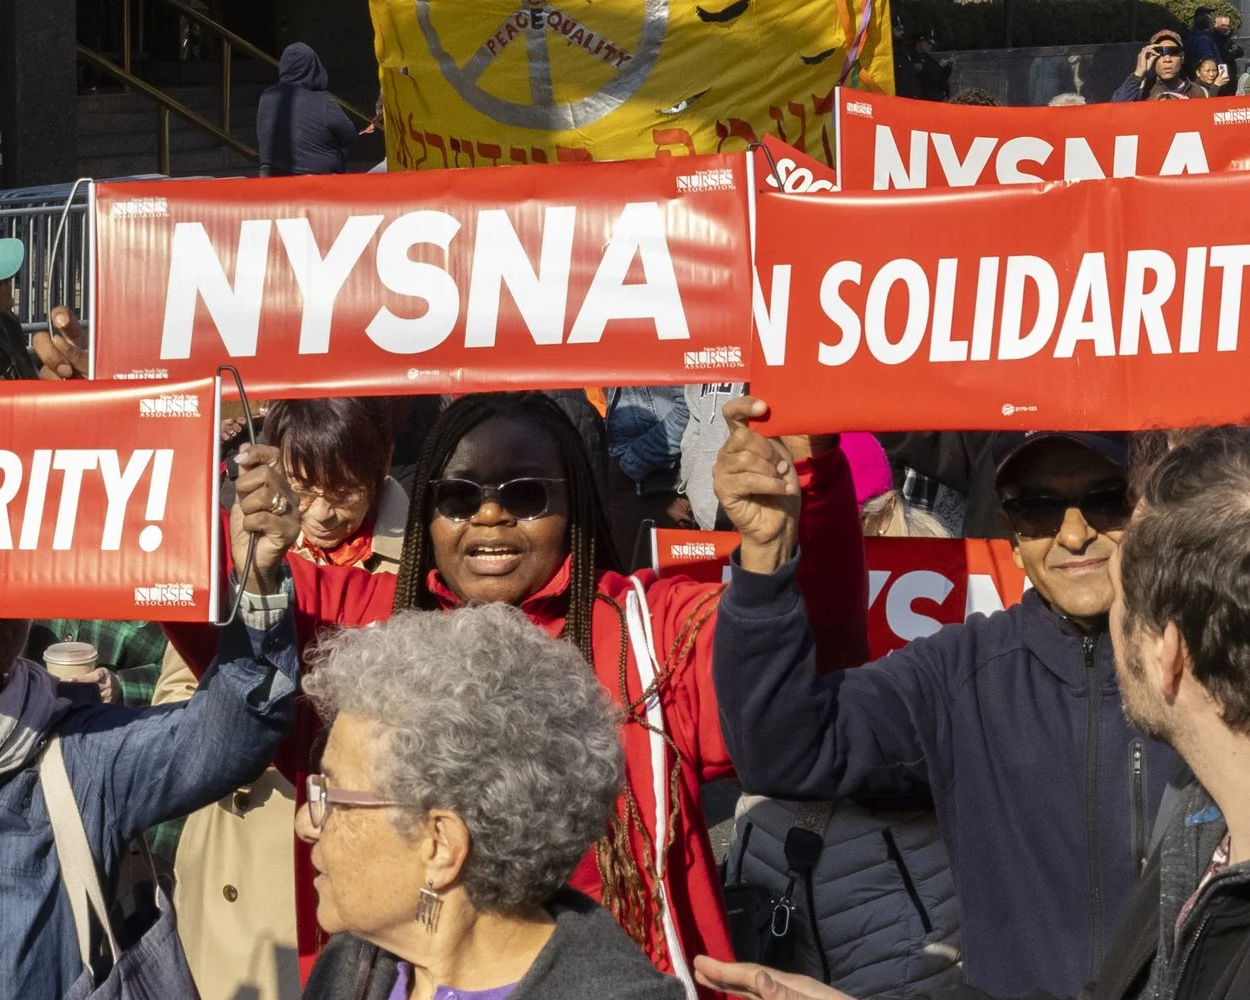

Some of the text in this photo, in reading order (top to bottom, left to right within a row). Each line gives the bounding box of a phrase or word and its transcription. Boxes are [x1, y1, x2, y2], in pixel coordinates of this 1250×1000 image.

[873, 124, 1211, 191] NYSNA
[676, 173, 733, 189] NURSES
[677, 184, 737, 193] ASSOCIATION
[159, 201, 691, 361] NYSNA
[817, 244, 1250, 367] SOLIDARIT
[684, 351, 742, 365] NURSES
[684, 362, 745, 370] ASSOCIATION
[140, 399, 199, 412] NURSES
[671, 545, 716, 556] NURSES
[135, 587, 194, 602] NURSES
